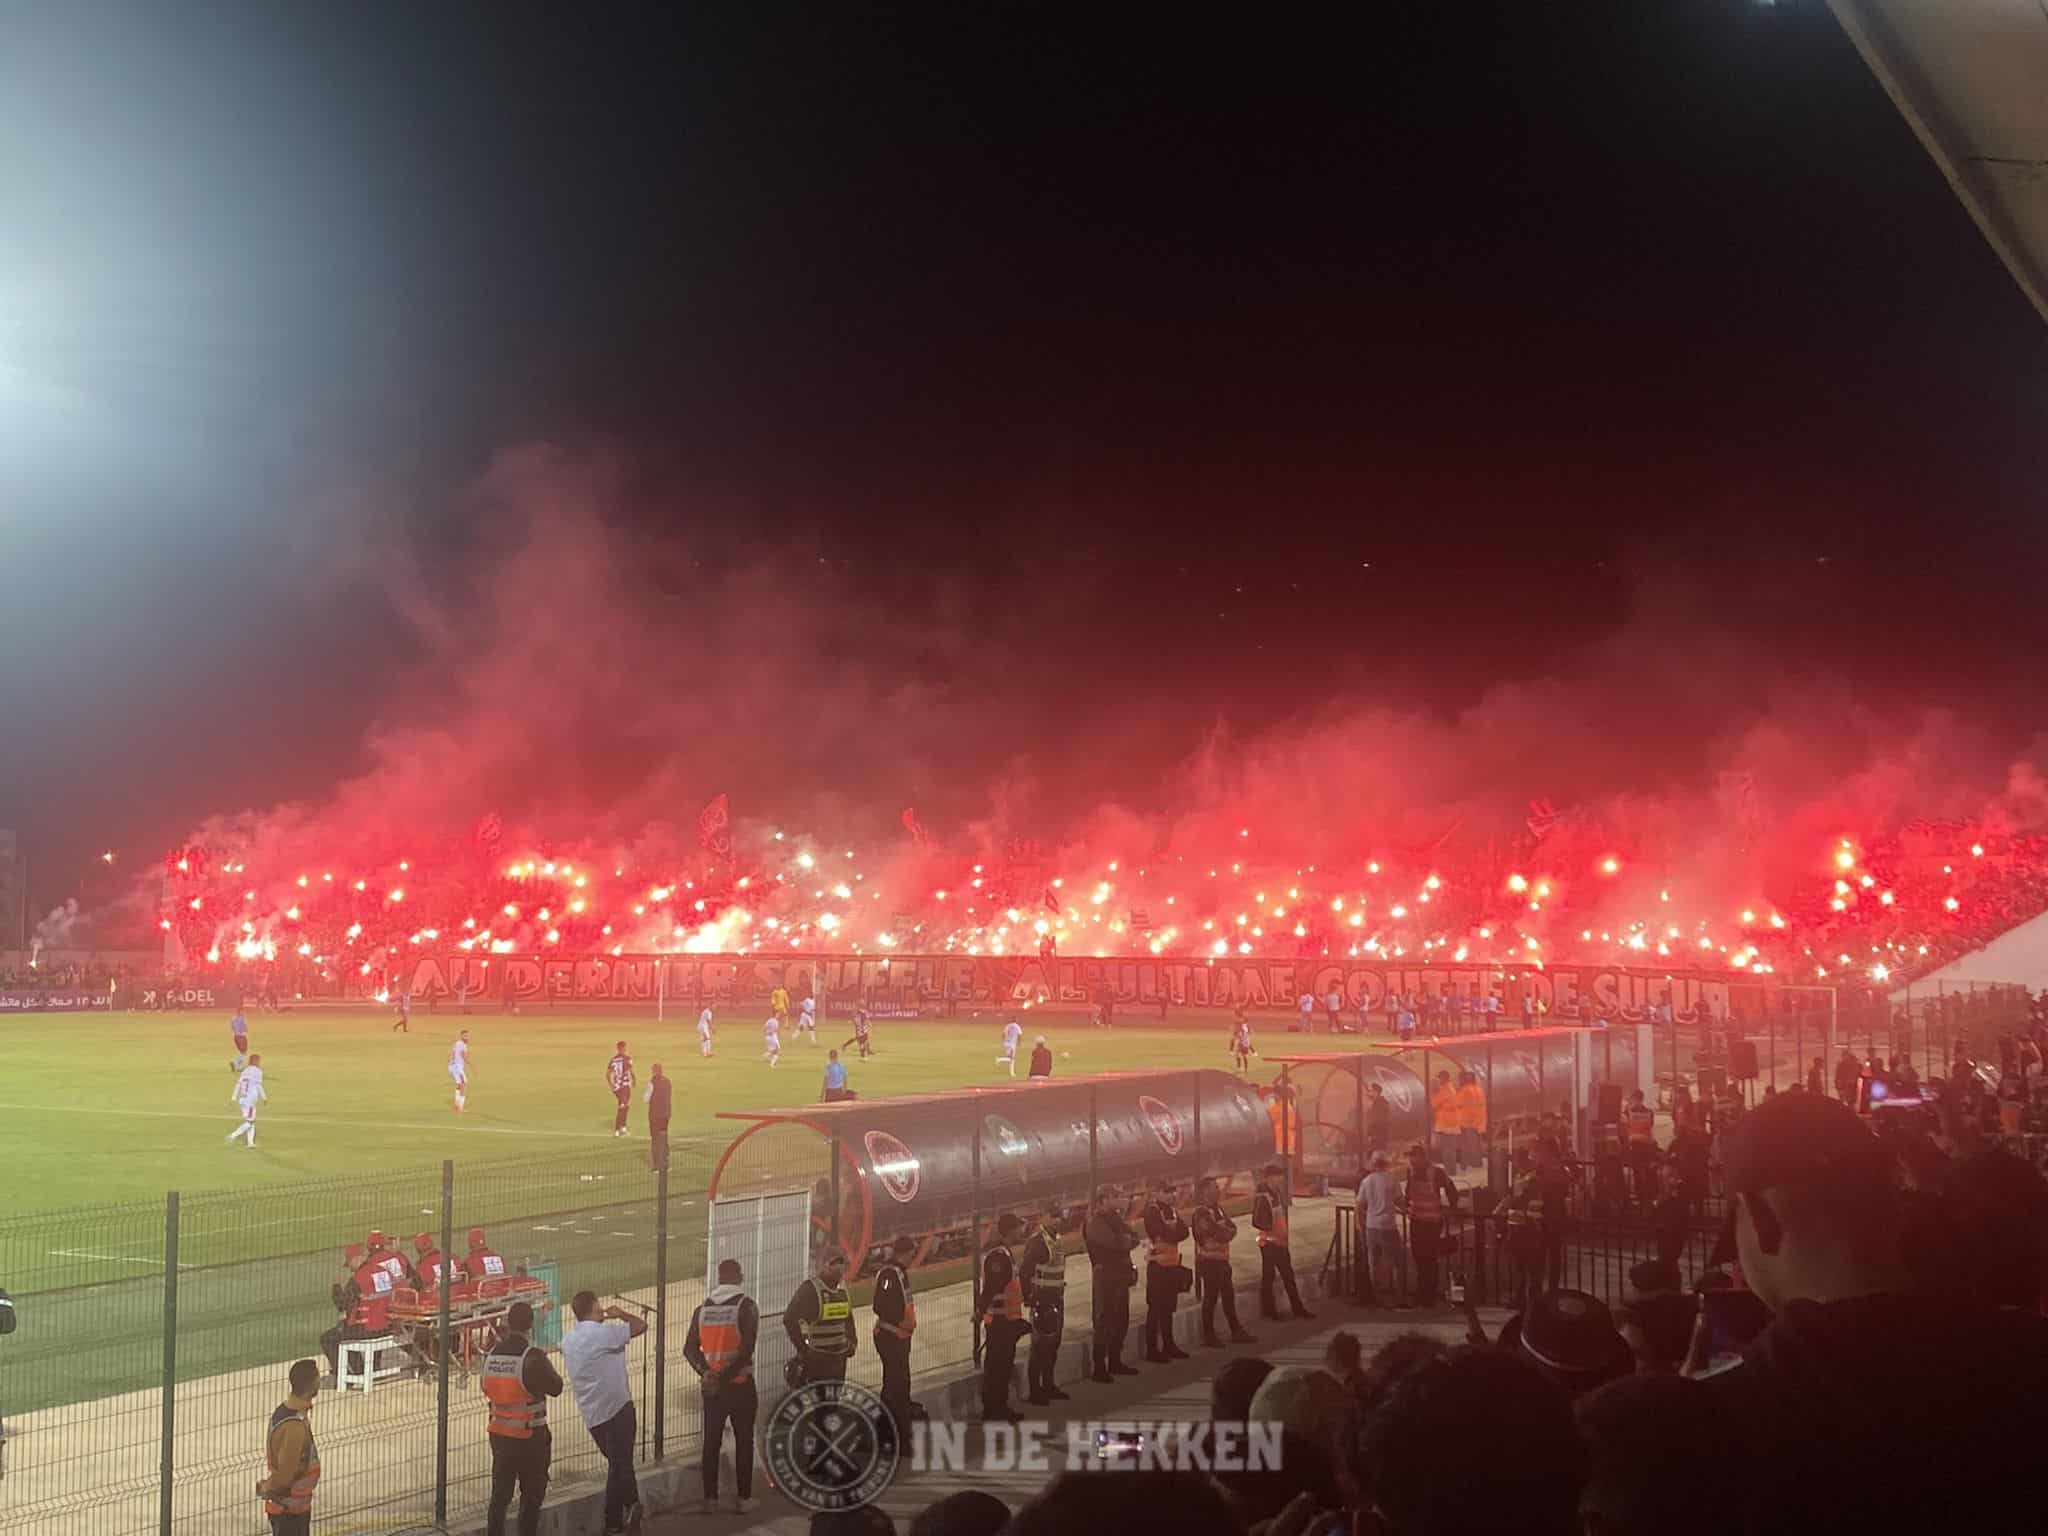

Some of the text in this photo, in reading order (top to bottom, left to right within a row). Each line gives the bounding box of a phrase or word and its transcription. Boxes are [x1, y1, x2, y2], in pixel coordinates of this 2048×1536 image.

[407, 958, 489, 998] AU
[505, 960, 736, 999] DERNIER
[1312, 965, 1503, 1015] GOUTTE
[1528, 970, 1582, 1017] DE
